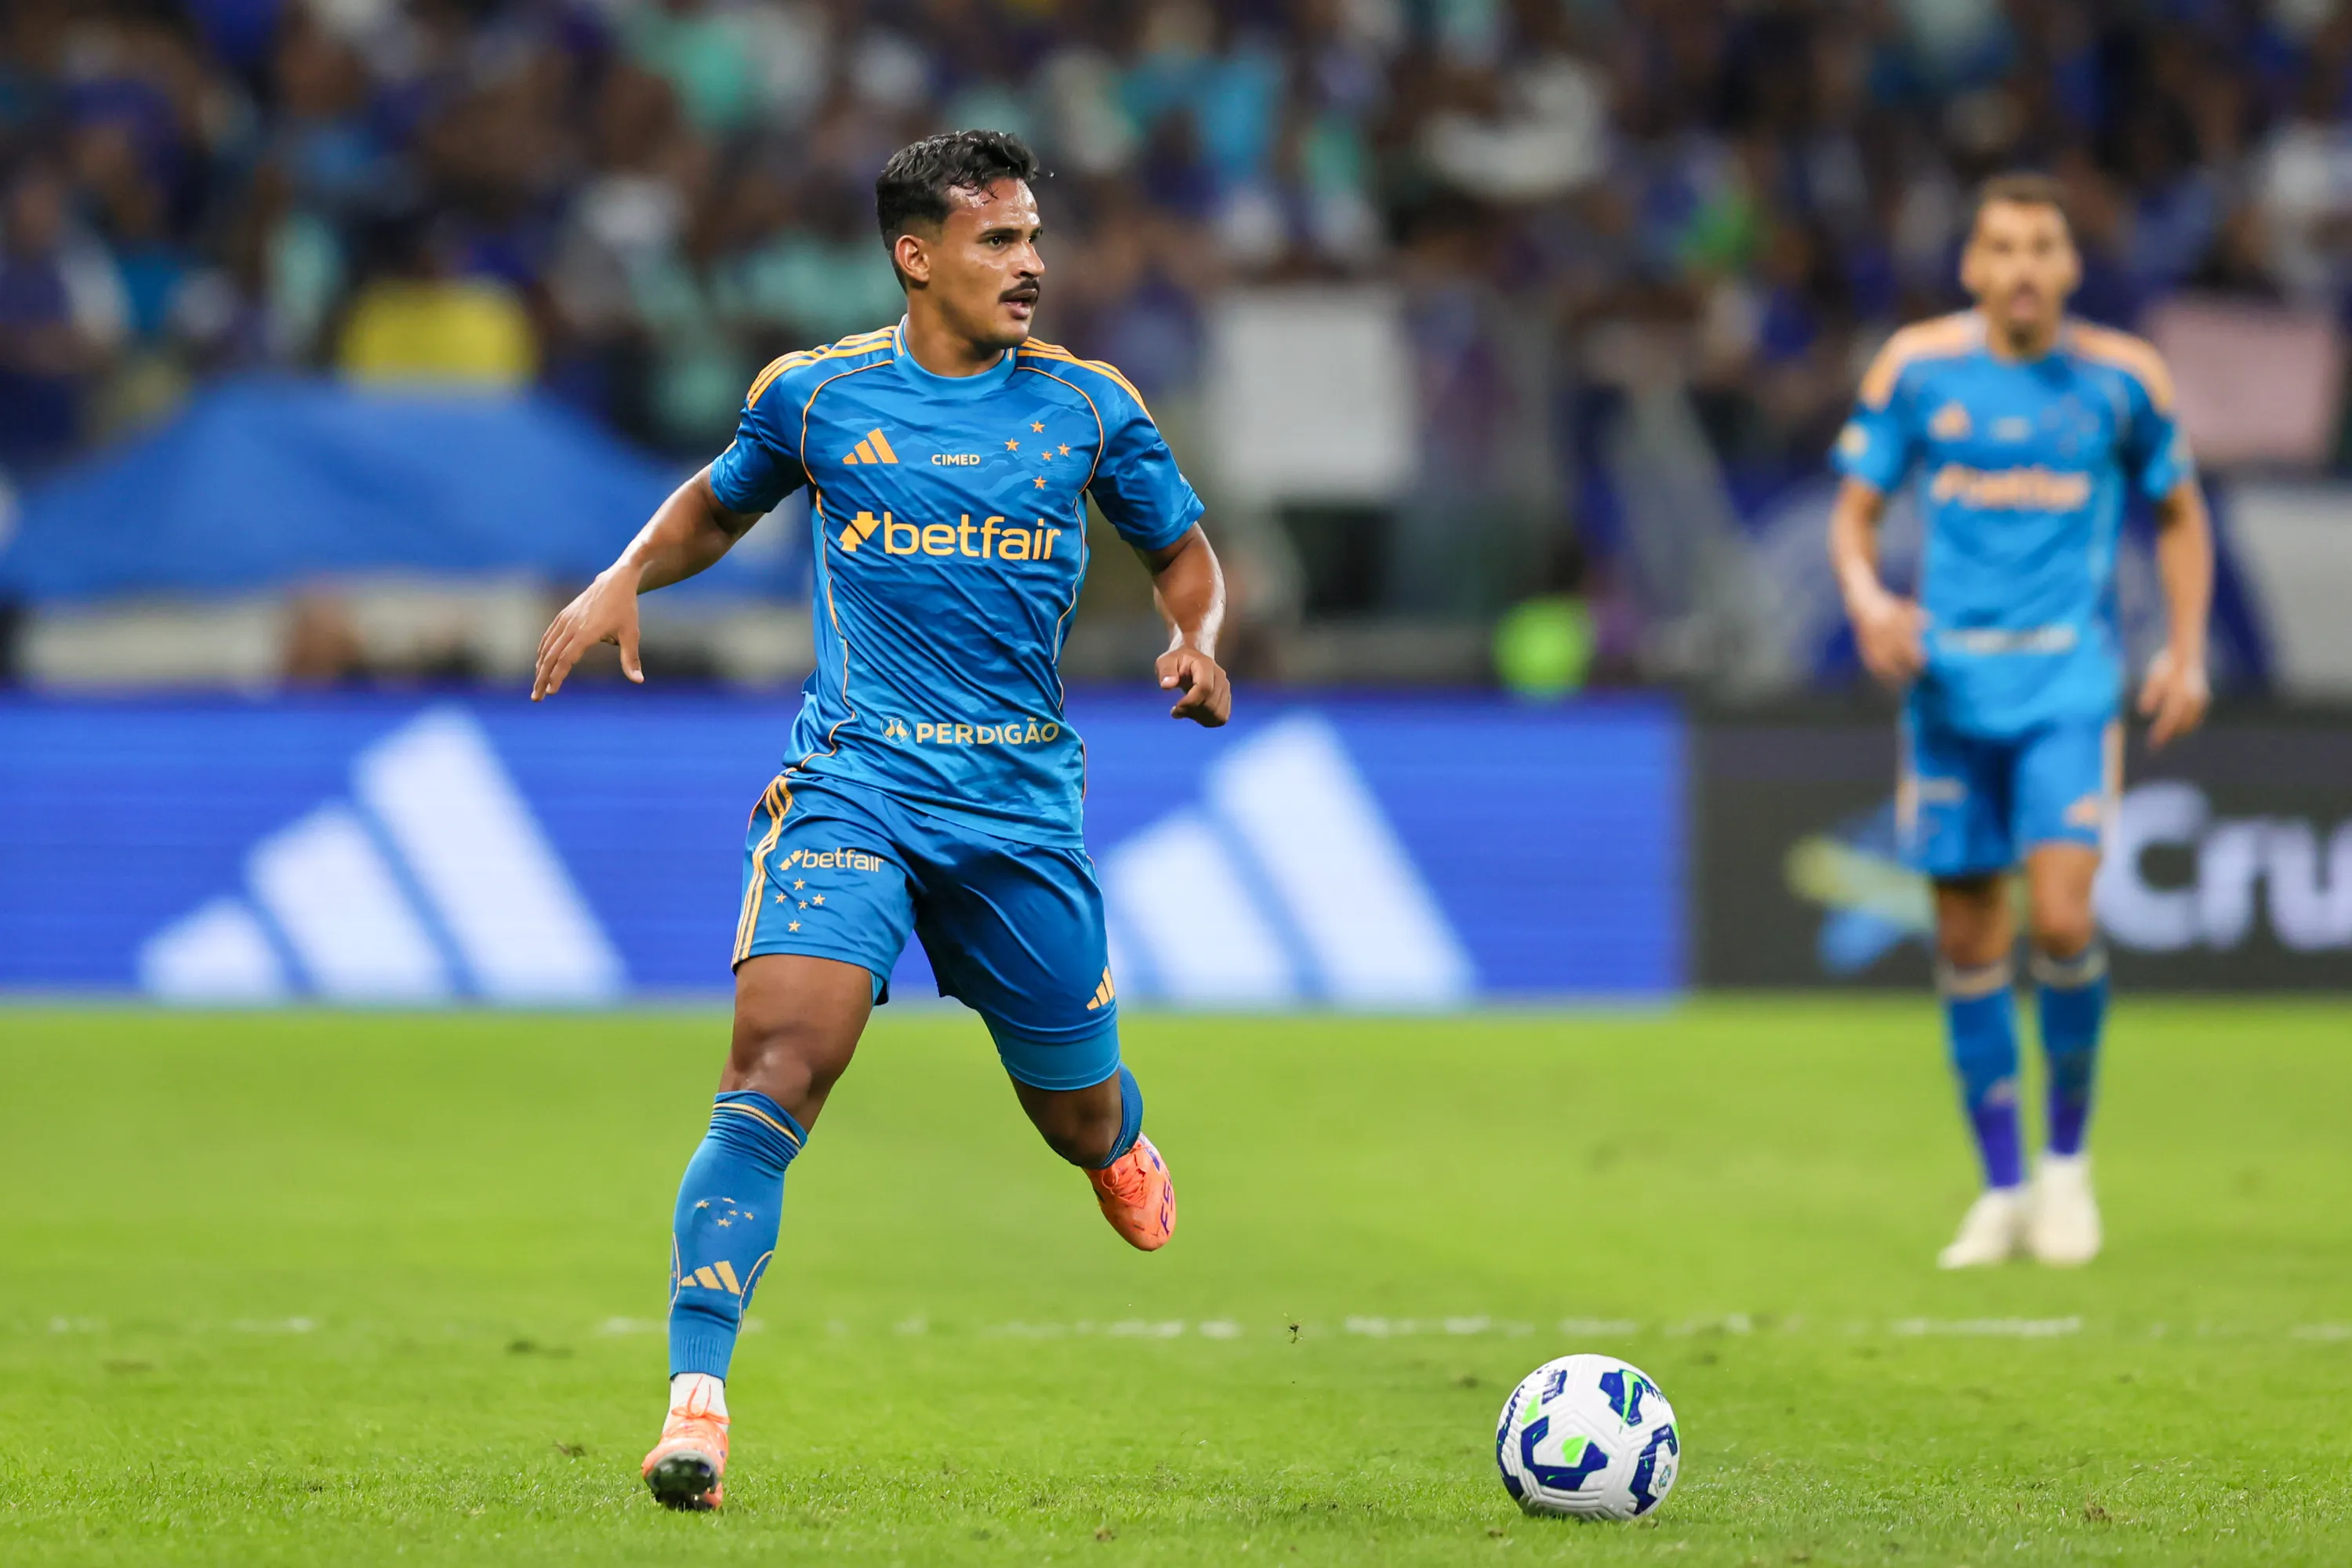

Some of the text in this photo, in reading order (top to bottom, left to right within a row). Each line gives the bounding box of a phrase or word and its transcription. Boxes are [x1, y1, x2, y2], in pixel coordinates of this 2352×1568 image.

[931, 454, 980, 466] CIMED
[884, 511, 1062, 560] betfair
[916, 717, 1059, 745] PERDIGÃO
[801, 847, 884, 873] betfair
